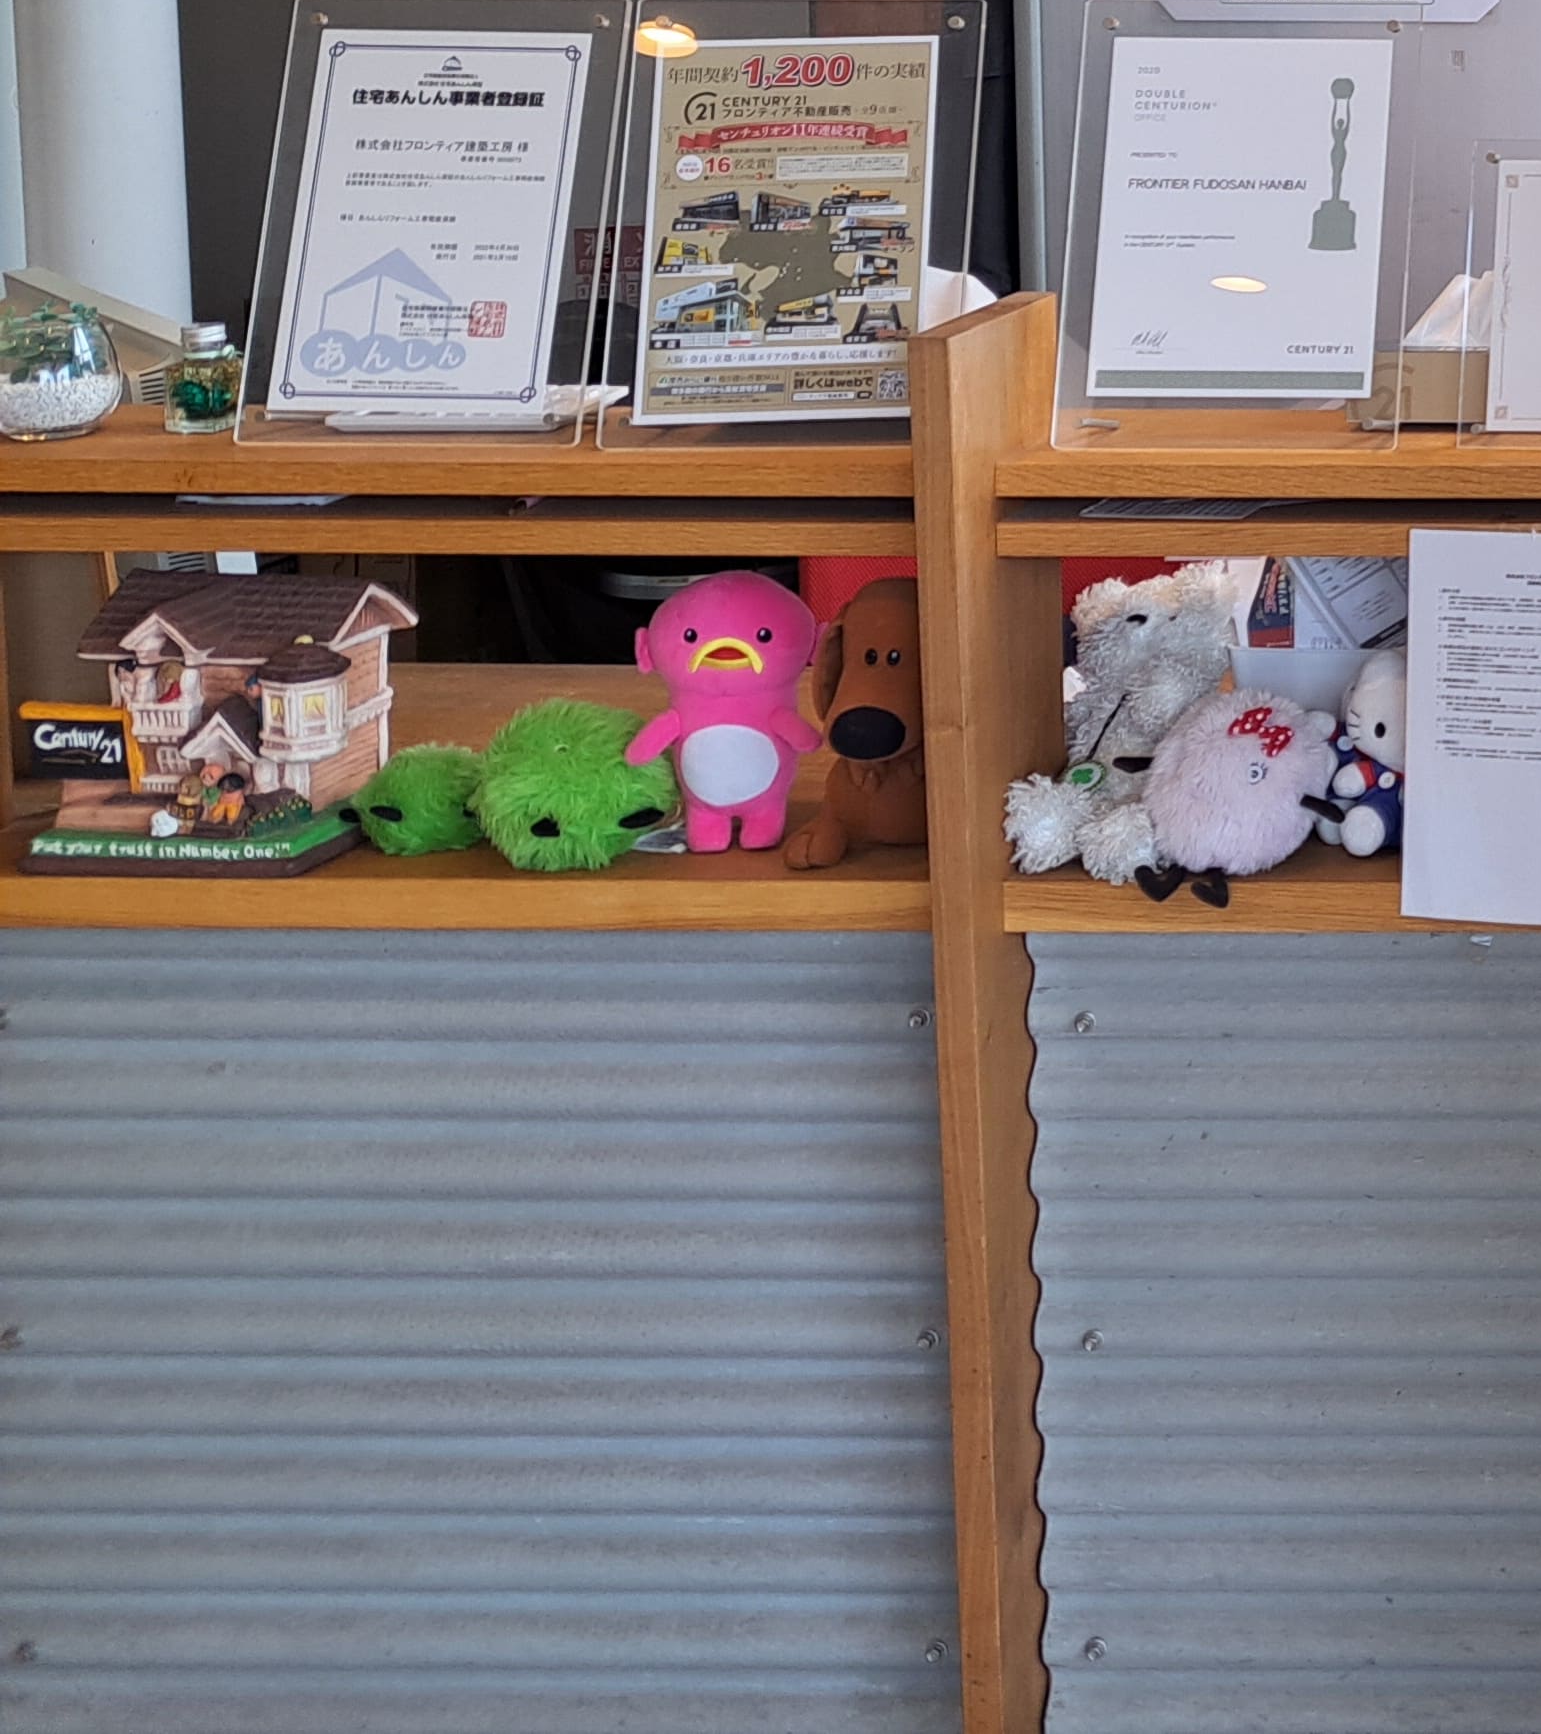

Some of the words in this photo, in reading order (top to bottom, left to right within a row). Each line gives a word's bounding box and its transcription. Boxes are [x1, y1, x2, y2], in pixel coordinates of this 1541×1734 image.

[352, 88, 545, 107] 住宅あんしん事業者登録証
[1135, 89, 1186, 98] DOUBLE
[722, 96, 791, 107] CENTURY
[794, 95, 807, 105] 21
[722, 106, 852, 118] フロンティア不動産販売
[1134, 114, 1167, 122] OFFICE
[1128, 178, 1189, 189] FRONTIER
[1193, 178, 1255, 190] FUDOSAN
[1258, 179, 1307, 191] HANBAI
[1287, 345, 1341, 355] CENTURY
[1343, 345, 1354, 355] 21
[793, 376, 873, 389] 詳しくはwebで
[33, 724, 106, 752] Century
[99, 736, 122, 764] 21
[108, 840, 154, 857] trust
[158, 842, 176, 857] in
[179, 842, 240, 860] Number
